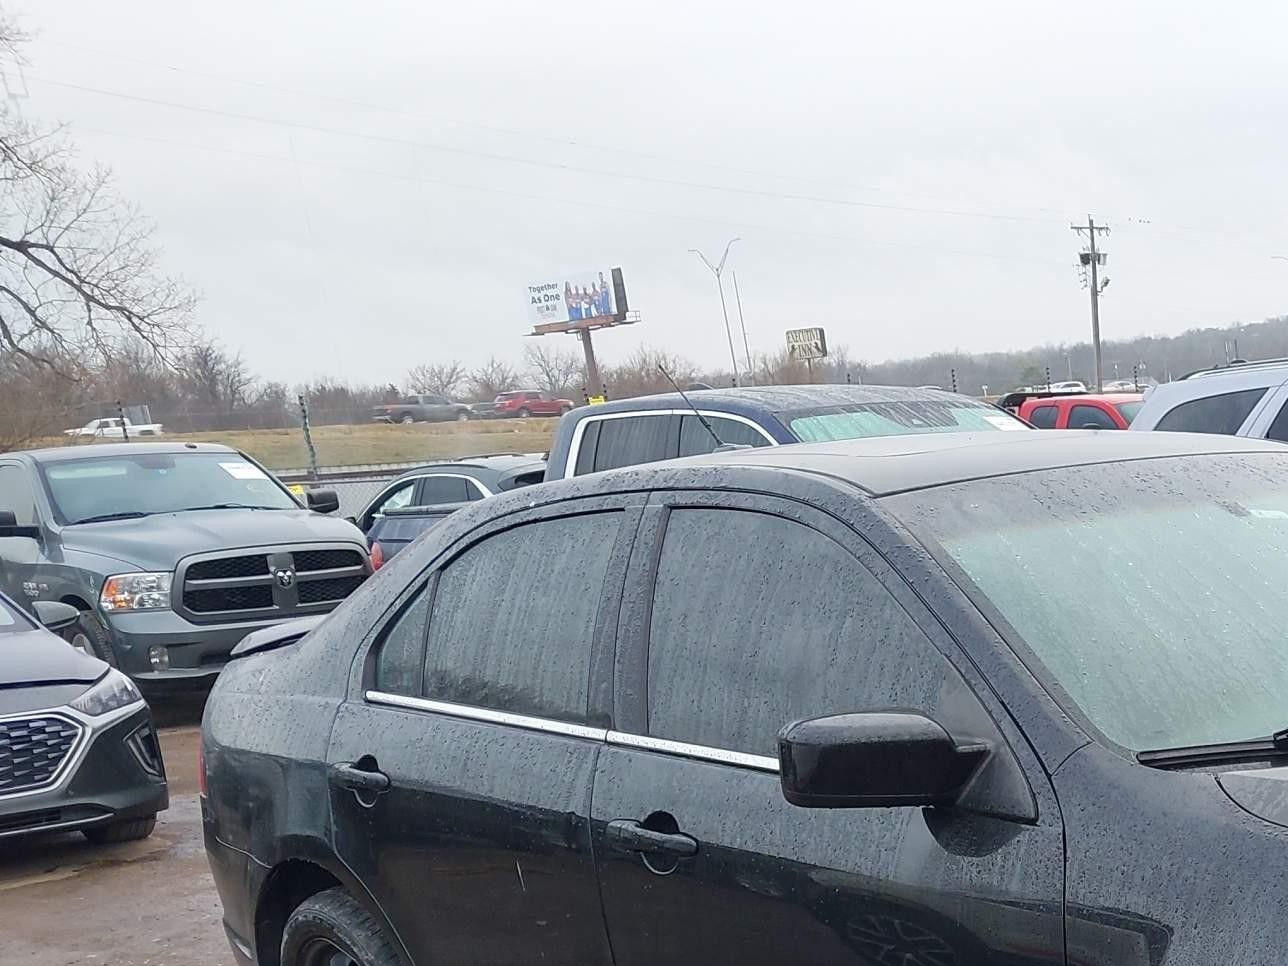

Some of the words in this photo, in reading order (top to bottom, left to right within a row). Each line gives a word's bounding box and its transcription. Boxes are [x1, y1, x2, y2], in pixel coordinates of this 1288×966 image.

[528, 283, 558, 294] Together
[531, 296, 542, 305] As
[543, 293, 561, 302] One
